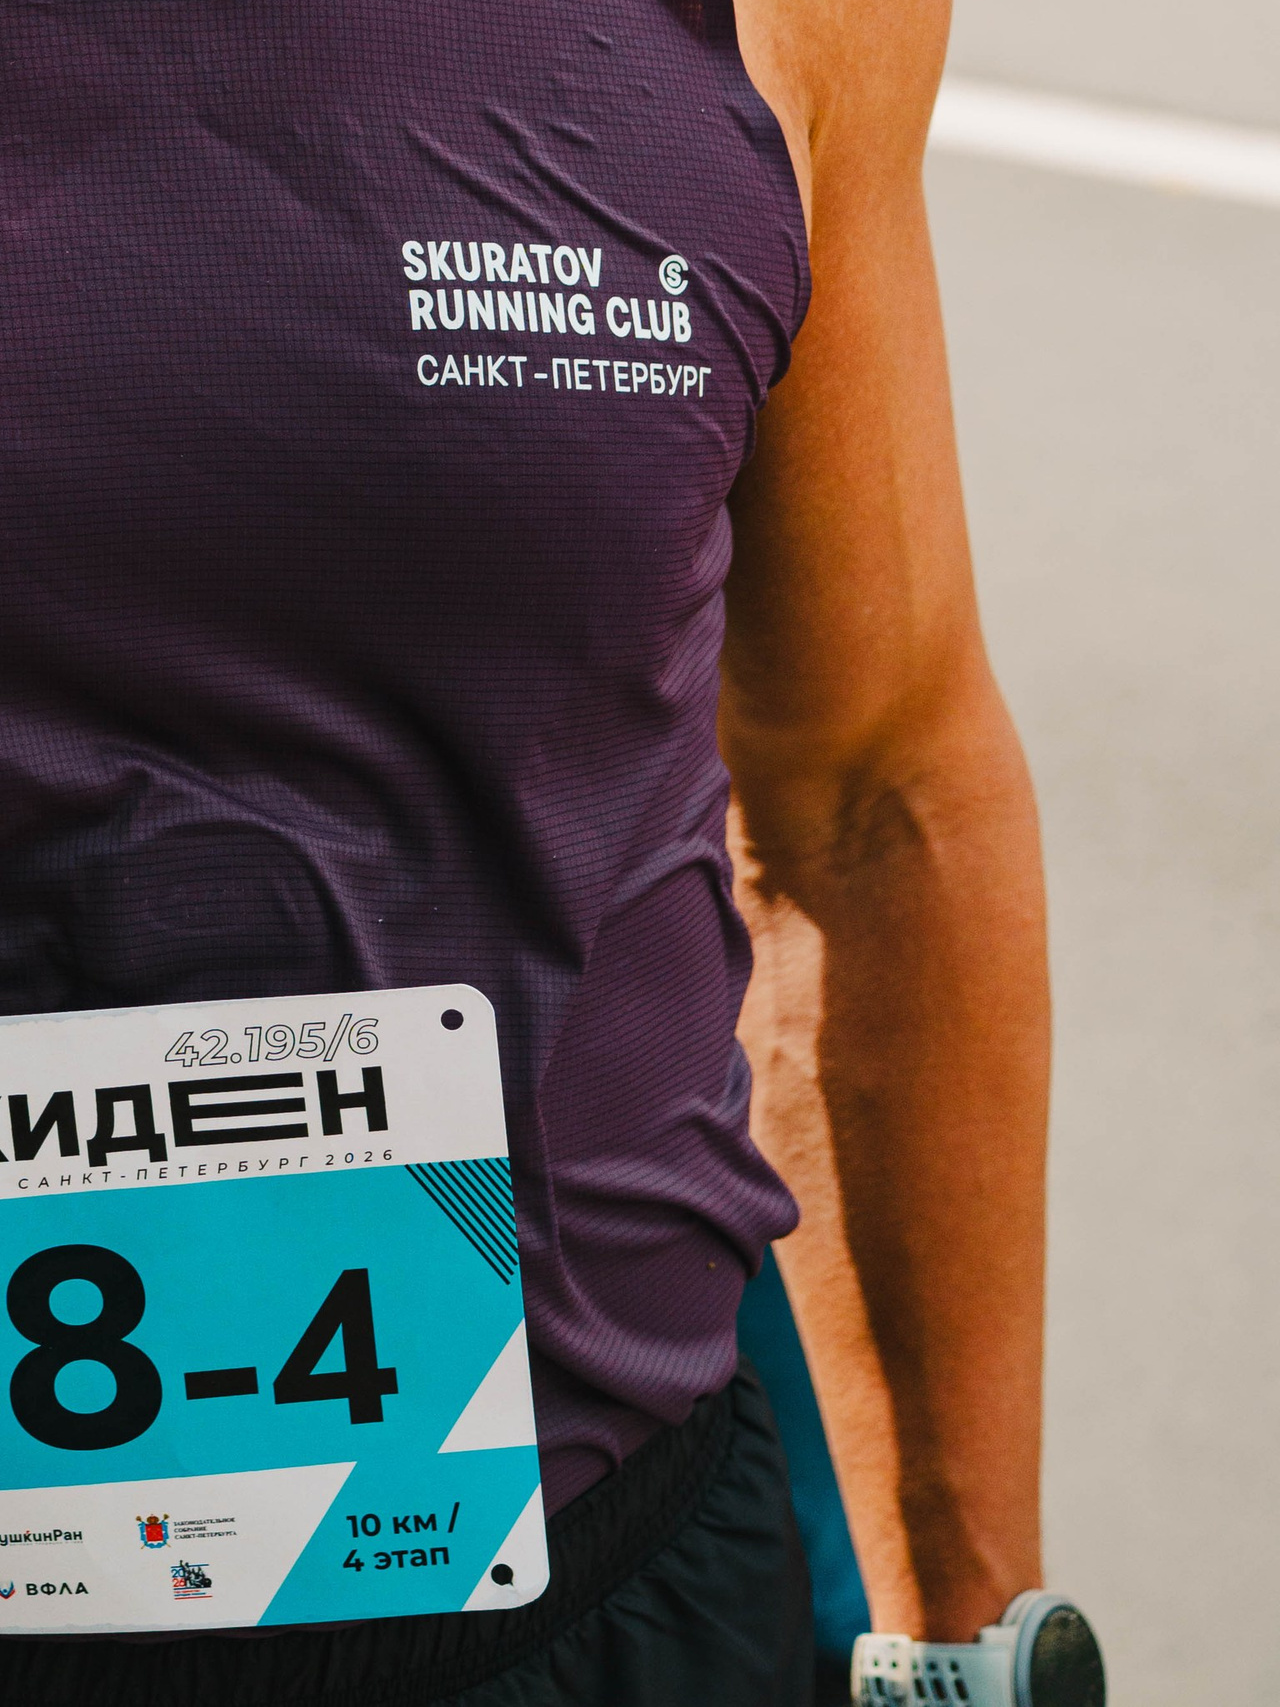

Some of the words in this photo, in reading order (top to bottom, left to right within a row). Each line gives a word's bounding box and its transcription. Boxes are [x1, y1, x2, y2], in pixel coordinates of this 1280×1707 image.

[402, 240, 602, 288] SKURATOV
[408, 289, 596, 335] RUNNING
[606, 296, 692, 343] CLUB
[417, 354, 712, 397] САНКТ-ПЕТЕРБУРГ
[165, 1013, 379, 1068] 42.195/6
[18, 1156, 309, 1190] САНКТ-ПЕТЕРБУРГ
[325, 1148, 394, 1166] 2026
[346, 1513, 381, 1538] 10
[393, 1513, 437, 1534] км
[447, 1501, 460, 1533] /
[343, 1549, 365, 1572] 4
[373, 1546, 450, 1570] этап
[26, 1582, 89, 1596] ВФЛА
